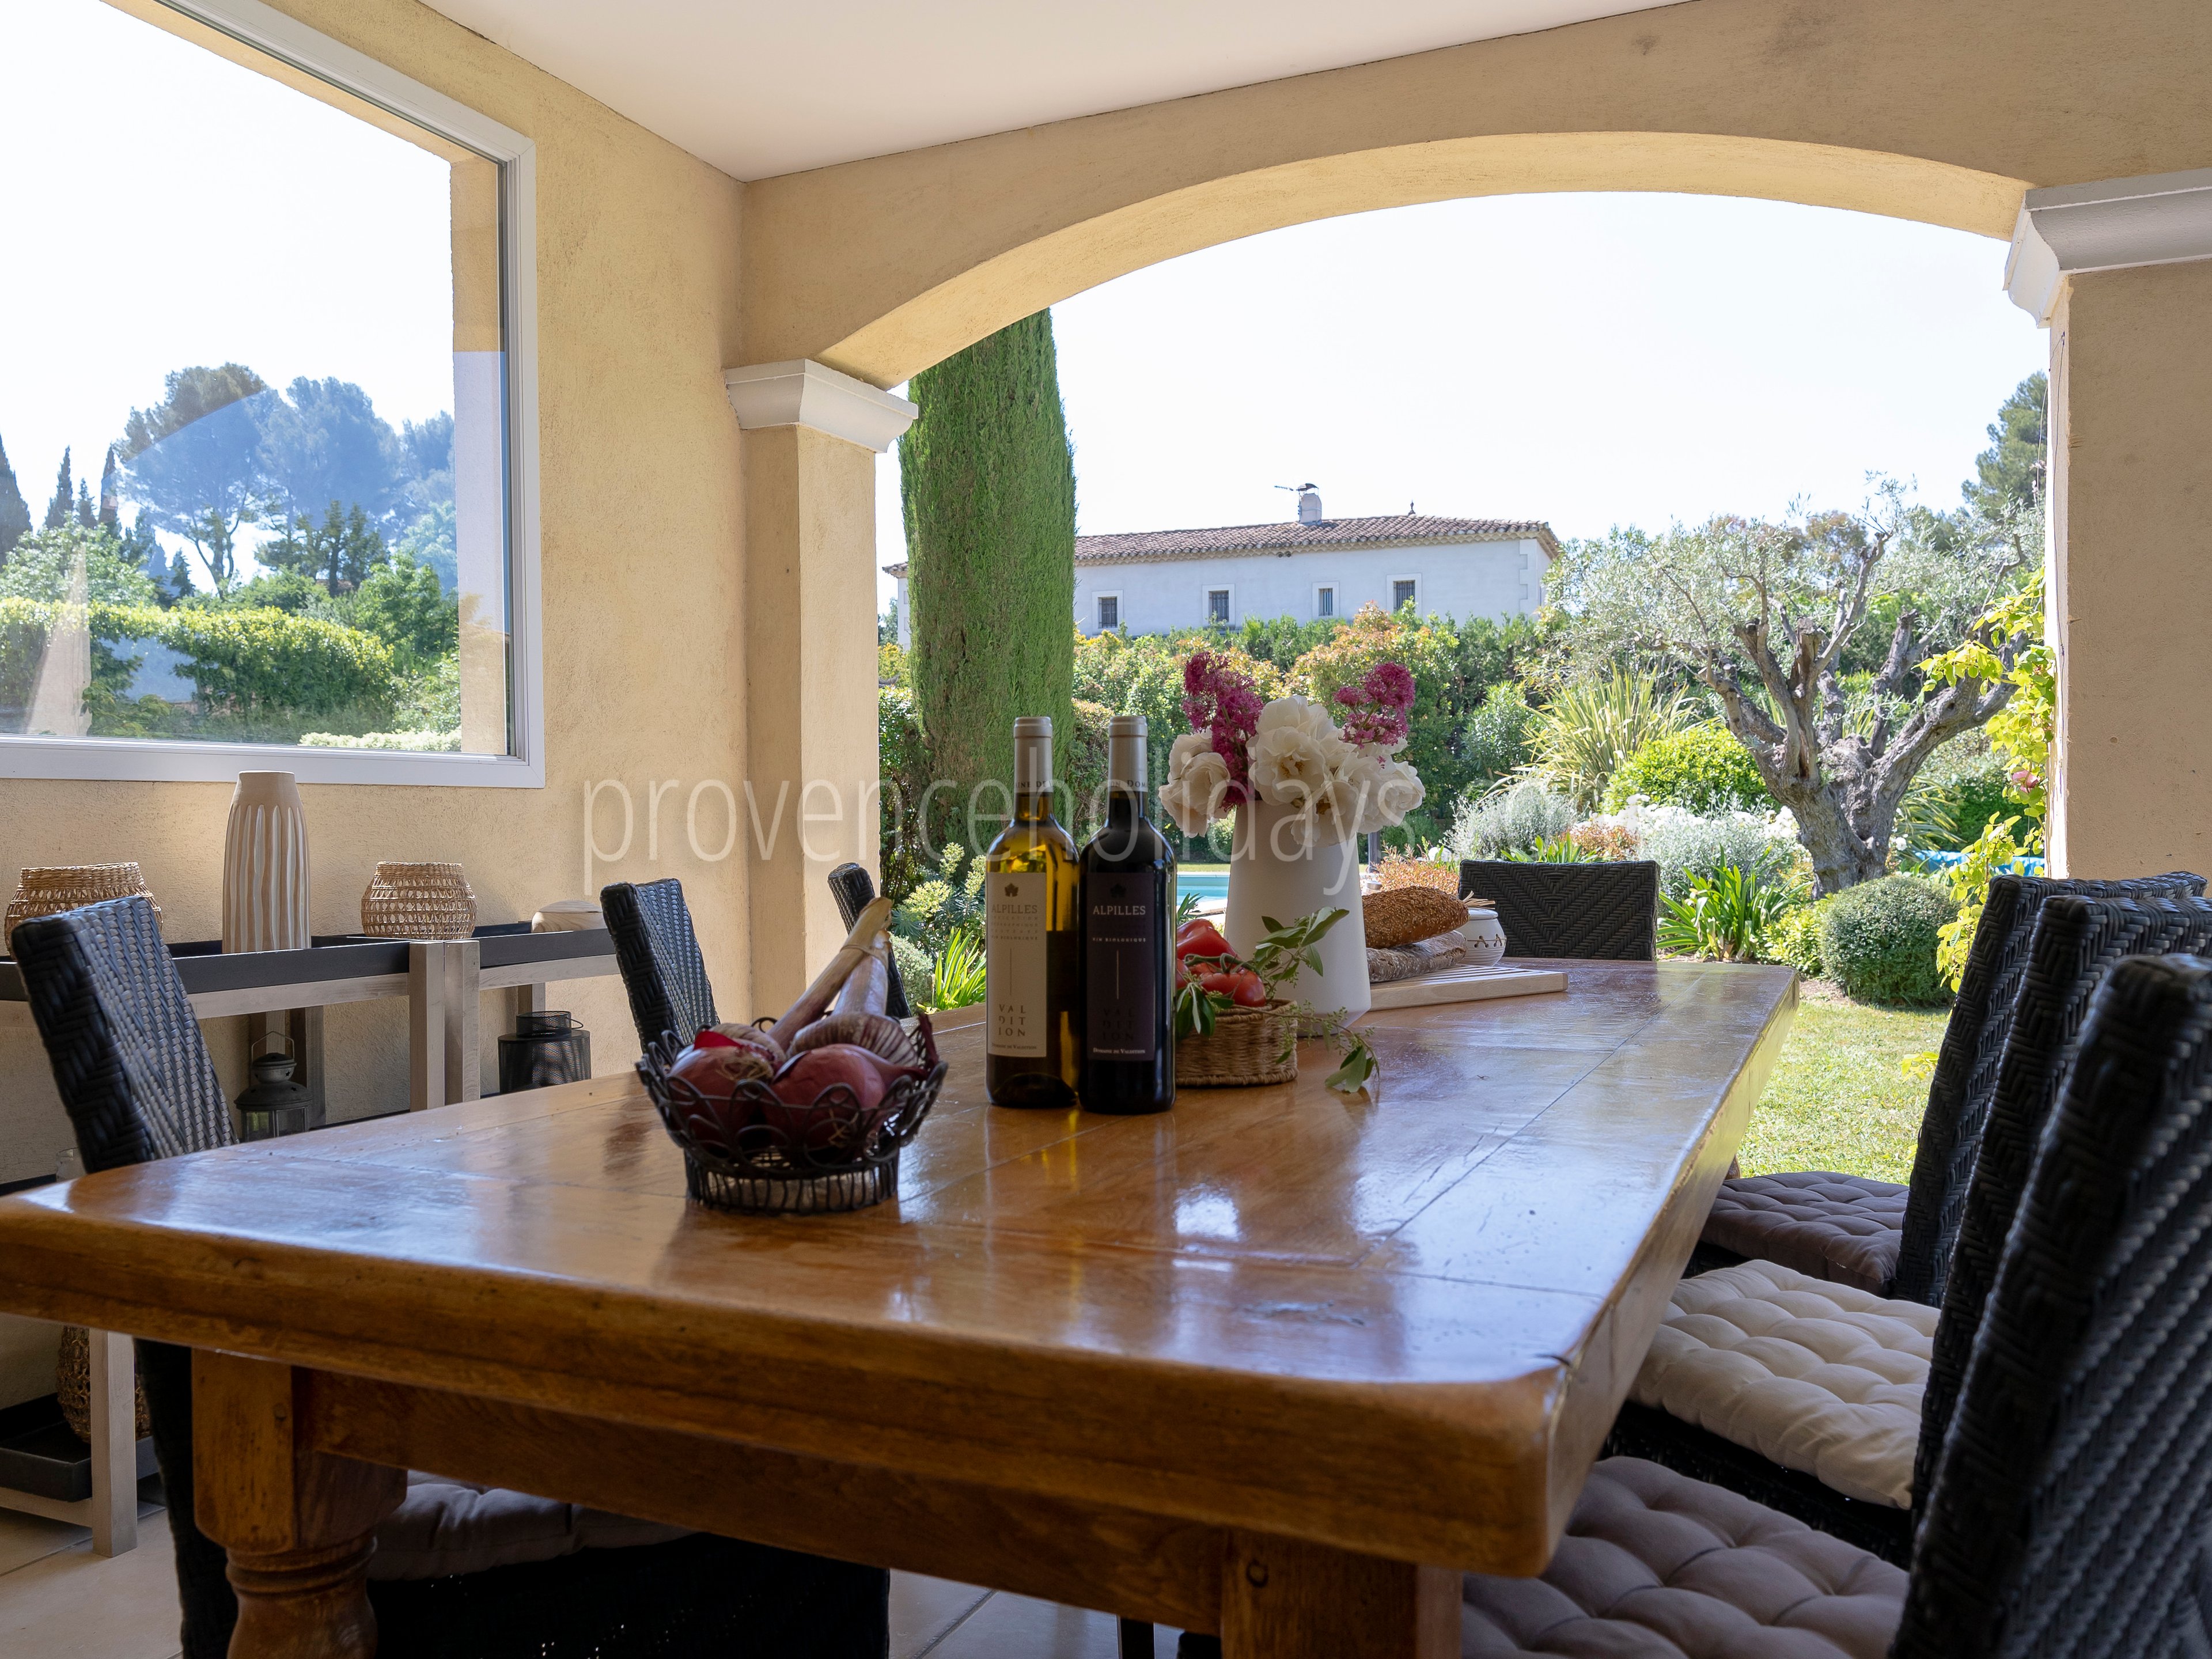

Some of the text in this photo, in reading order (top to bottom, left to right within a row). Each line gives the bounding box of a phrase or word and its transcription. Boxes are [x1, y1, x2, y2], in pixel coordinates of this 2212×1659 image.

[991, 904, 1037, 914] ALPILLES
[1093, 906, 1146, 915] ALPILLES
[999, 1004, 1026, 1014] VAL
[998, 1016, 1026, 1025] DIT
[998, 1027, 1025, 1037] ION
